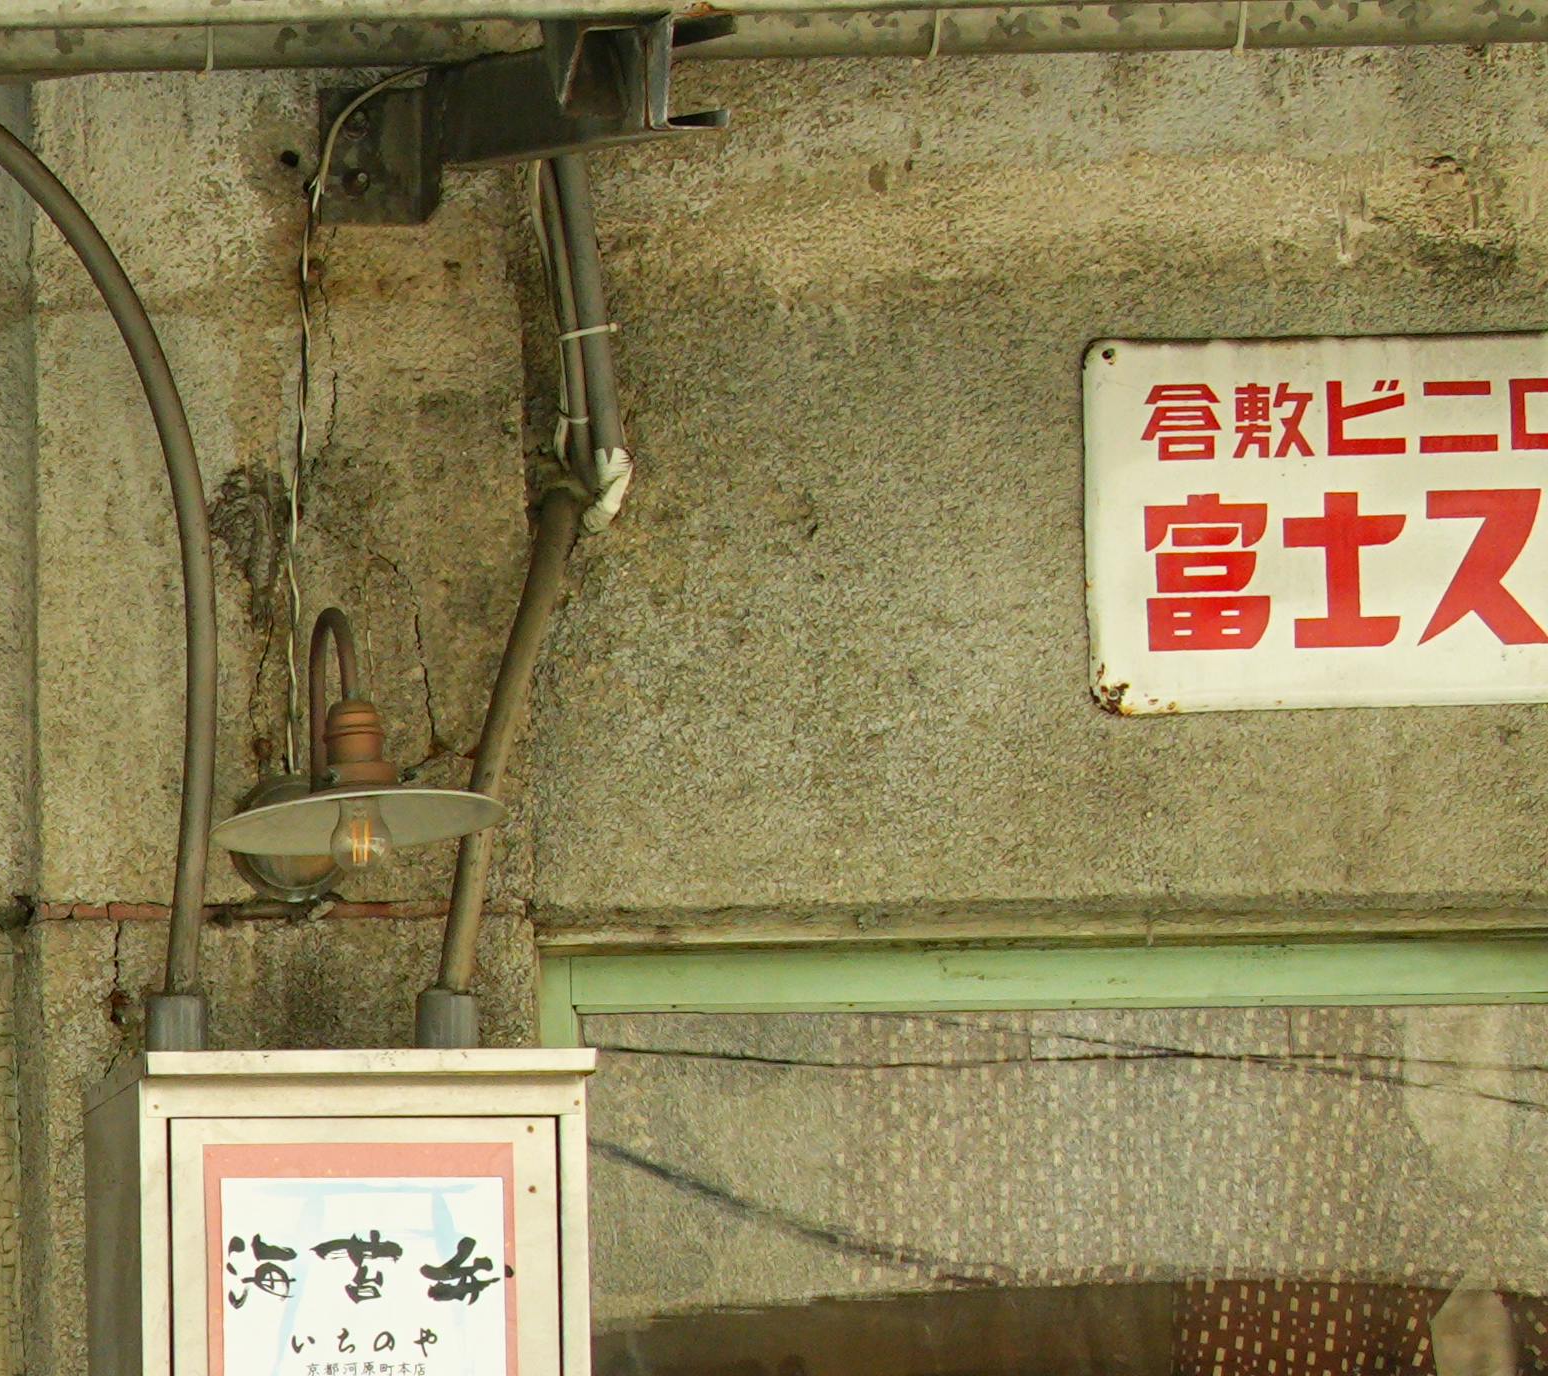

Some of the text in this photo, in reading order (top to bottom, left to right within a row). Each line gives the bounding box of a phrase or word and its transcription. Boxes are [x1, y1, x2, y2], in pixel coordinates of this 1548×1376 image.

[1143, 488, 1548, 652] 富士ス
[226, 1229, 501, 1310] 海苔弁
[291, 1328, 438, 1357] いちのや
[305, 1361, 426, 1376] 京都河原町本店
